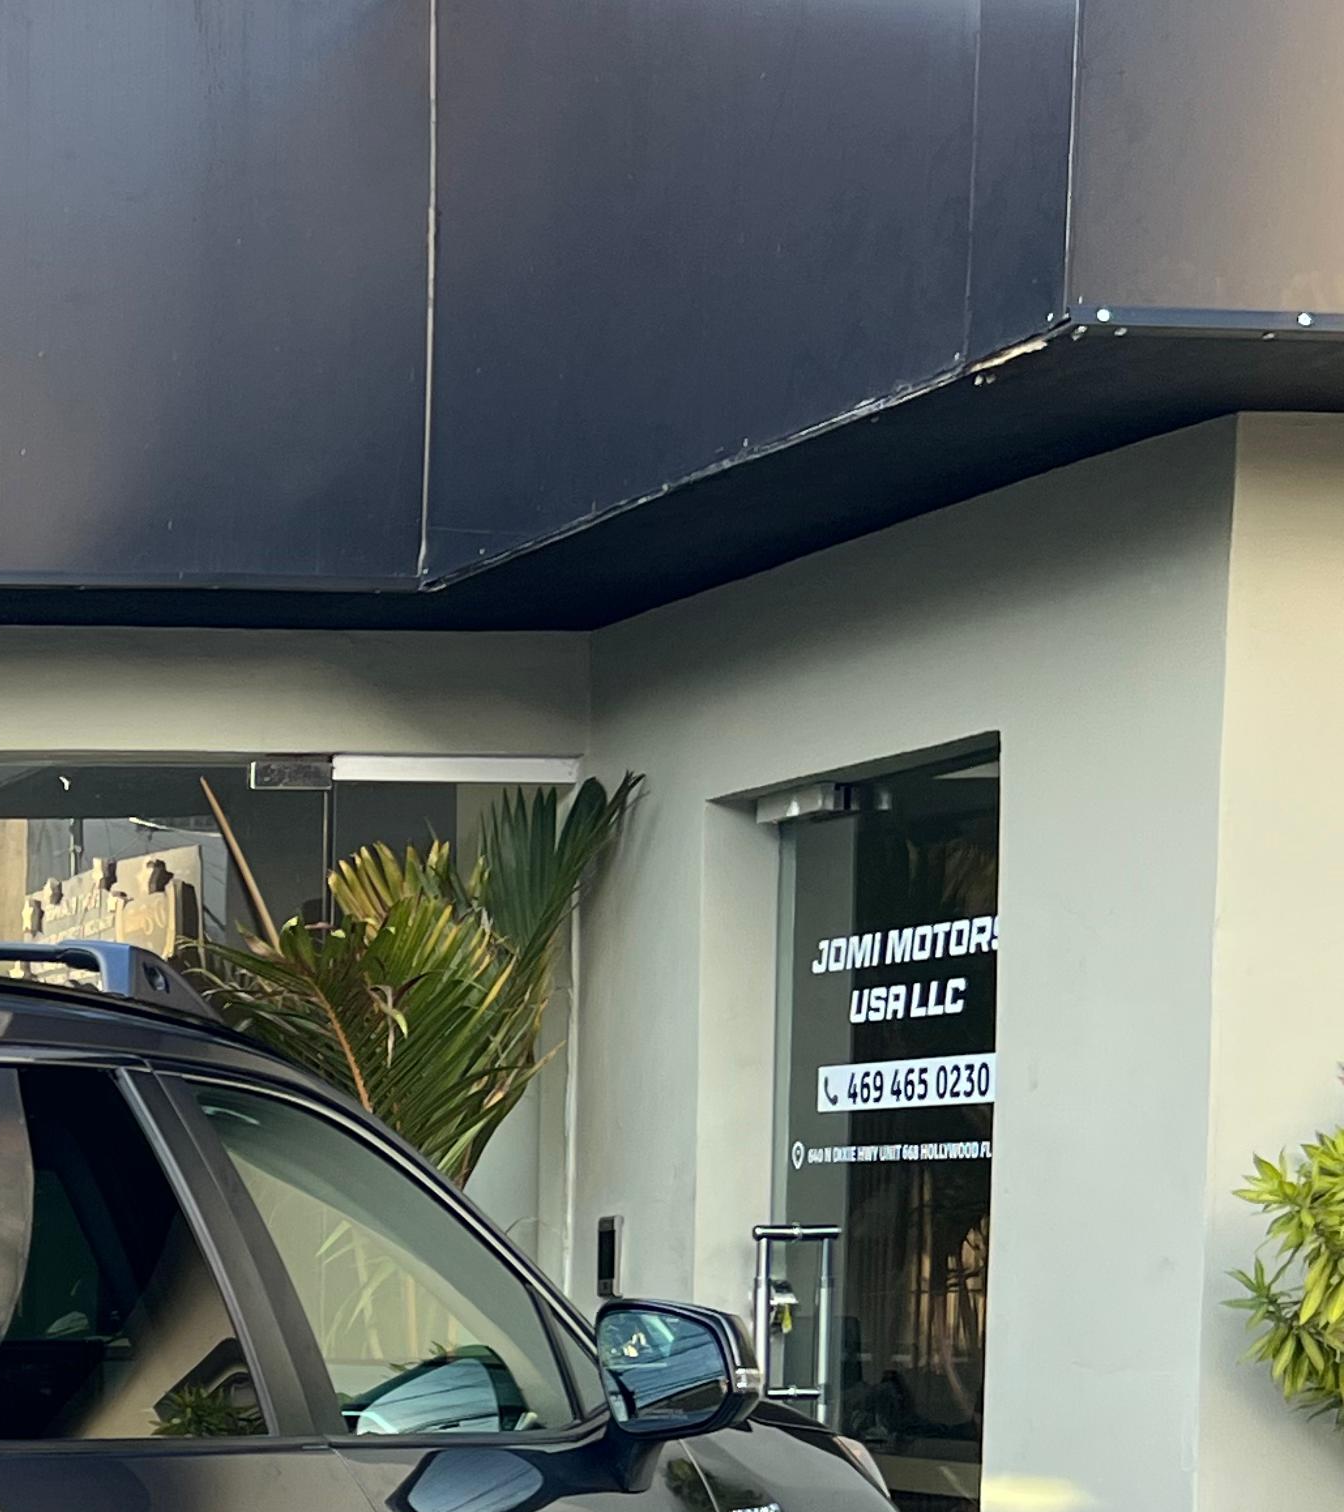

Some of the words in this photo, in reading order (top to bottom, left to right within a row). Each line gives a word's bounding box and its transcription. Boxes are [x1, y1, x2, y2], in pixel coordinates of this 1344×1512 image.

[811, 931, 883, 974] JOMI
[849, 985, 907, 1023] USA
[909, 977, 967, 1018] LLC
[847, 1070, 884, 1105] 469
[890, 1066, 929, 1102] 465
[936, 1062, 990, 1098] 0230
[920, 1141, 979, 1160] HOLLYWOOD
